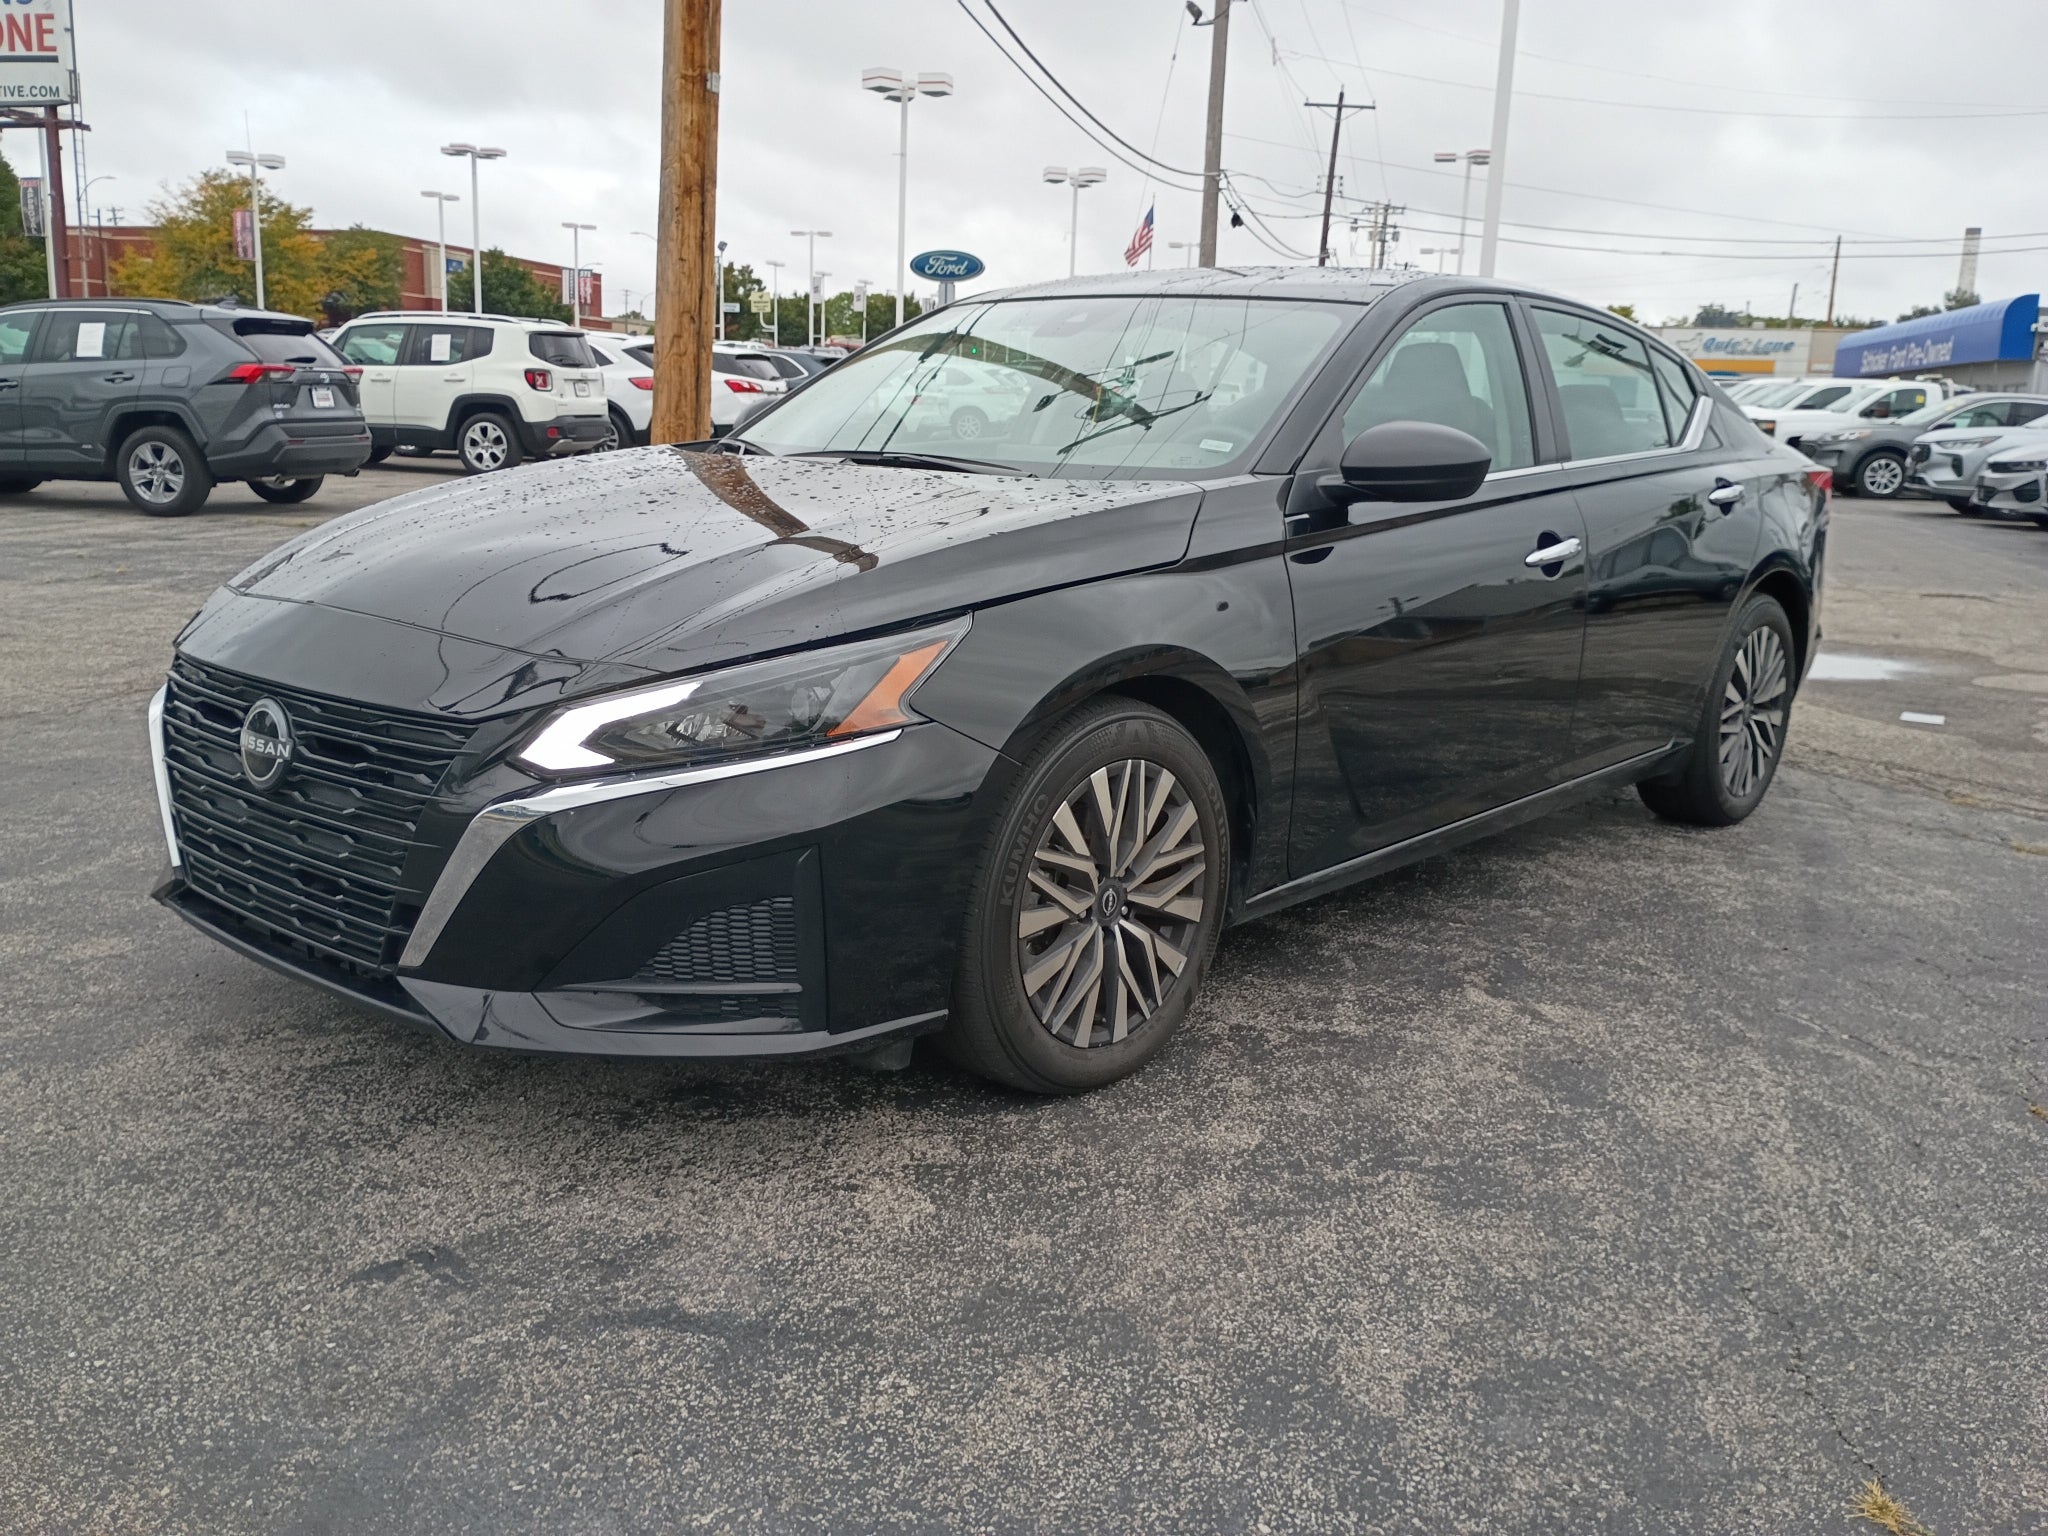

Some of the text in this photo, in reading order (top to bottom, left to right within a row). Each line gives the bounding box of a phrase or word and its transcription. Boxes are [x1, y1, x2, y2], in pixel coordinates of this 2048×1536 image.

[0, 13, 57, 52] NE
[924, 255, 969, 275] Ford
[242, 730, 290, 758] ISSAN
[1000, 794, 1049, 905] KUMHO
